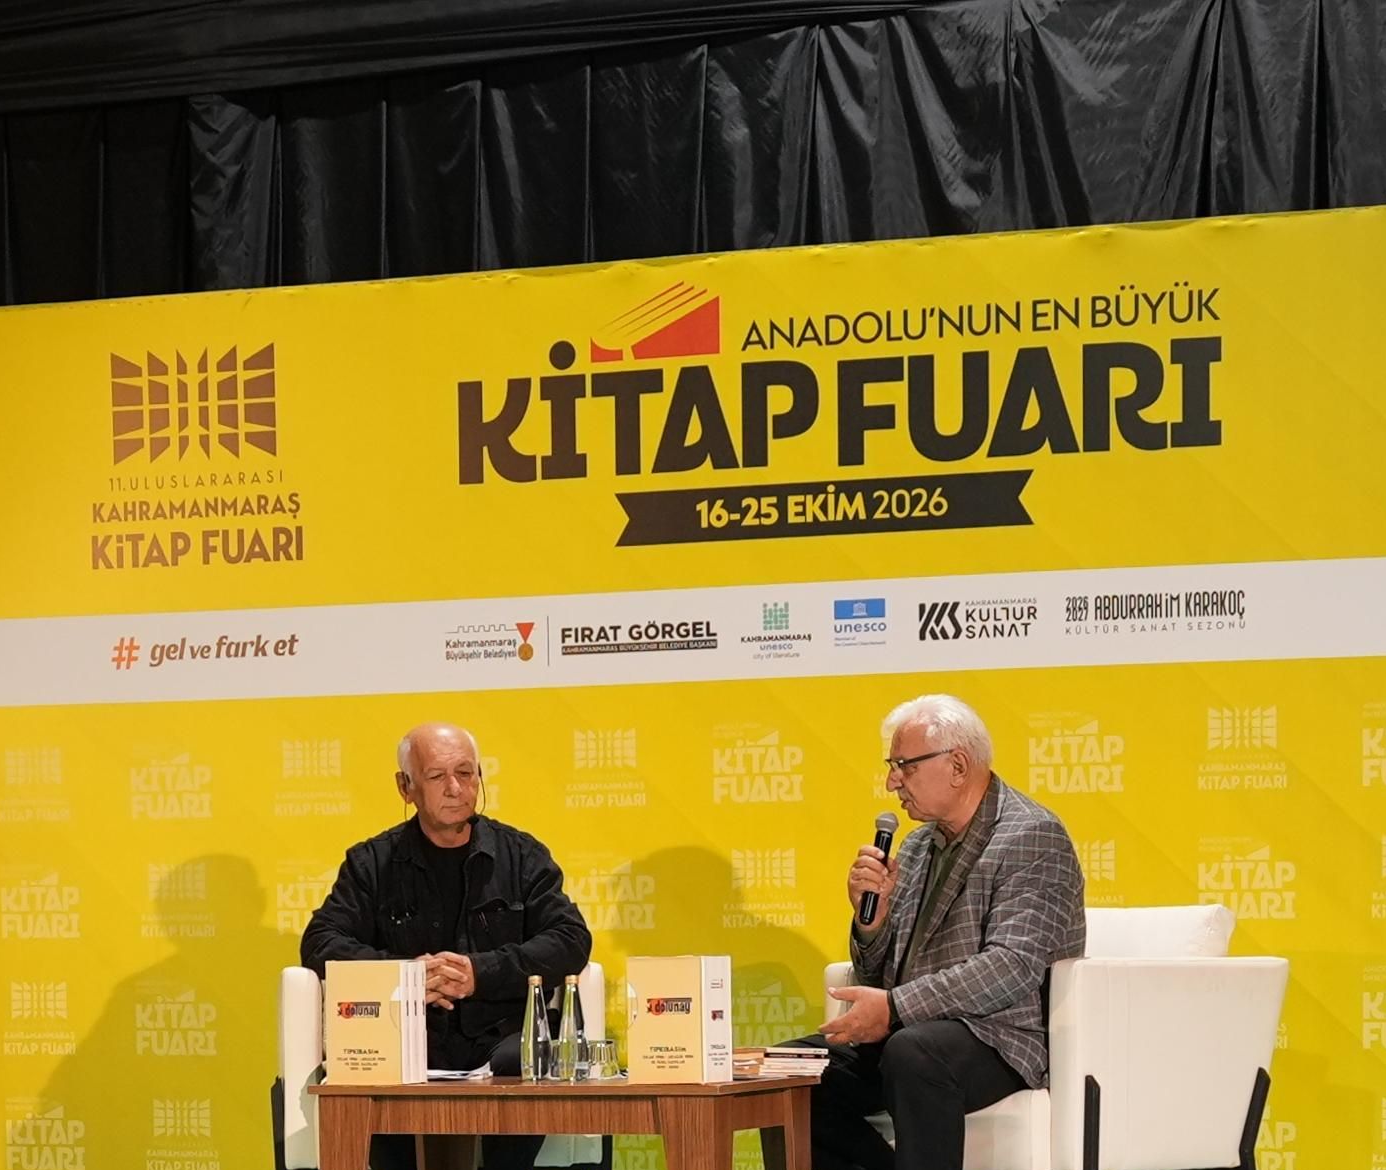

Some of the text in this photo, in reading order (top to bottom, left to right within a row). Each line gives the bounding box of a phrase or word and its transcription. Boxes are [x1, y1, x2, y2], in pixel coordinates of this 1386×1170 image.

[1031, 297, 1080, 332] EN
[1091, 281, 1221, 327] BÜYÜK
[837, 336, 1222, 467] FUARI
[92, 493, 301, 523] KAHRAMANMARAŞ
[696, 492, 779, 529] 16-25
[872, 487, 948, 520] 2026
[202, 526, 304, 565] FUARI
[1185, 590, 1245, 619] KARAKOÇ
[561, 620, 717, 643] FIRAT GÖRGEL
[834, 622, 887, 633] unesco
[1130, 622, 1177, 633] SANAT
[215, 635, 269, 659] fark
[273, 633, 299, 656] et
